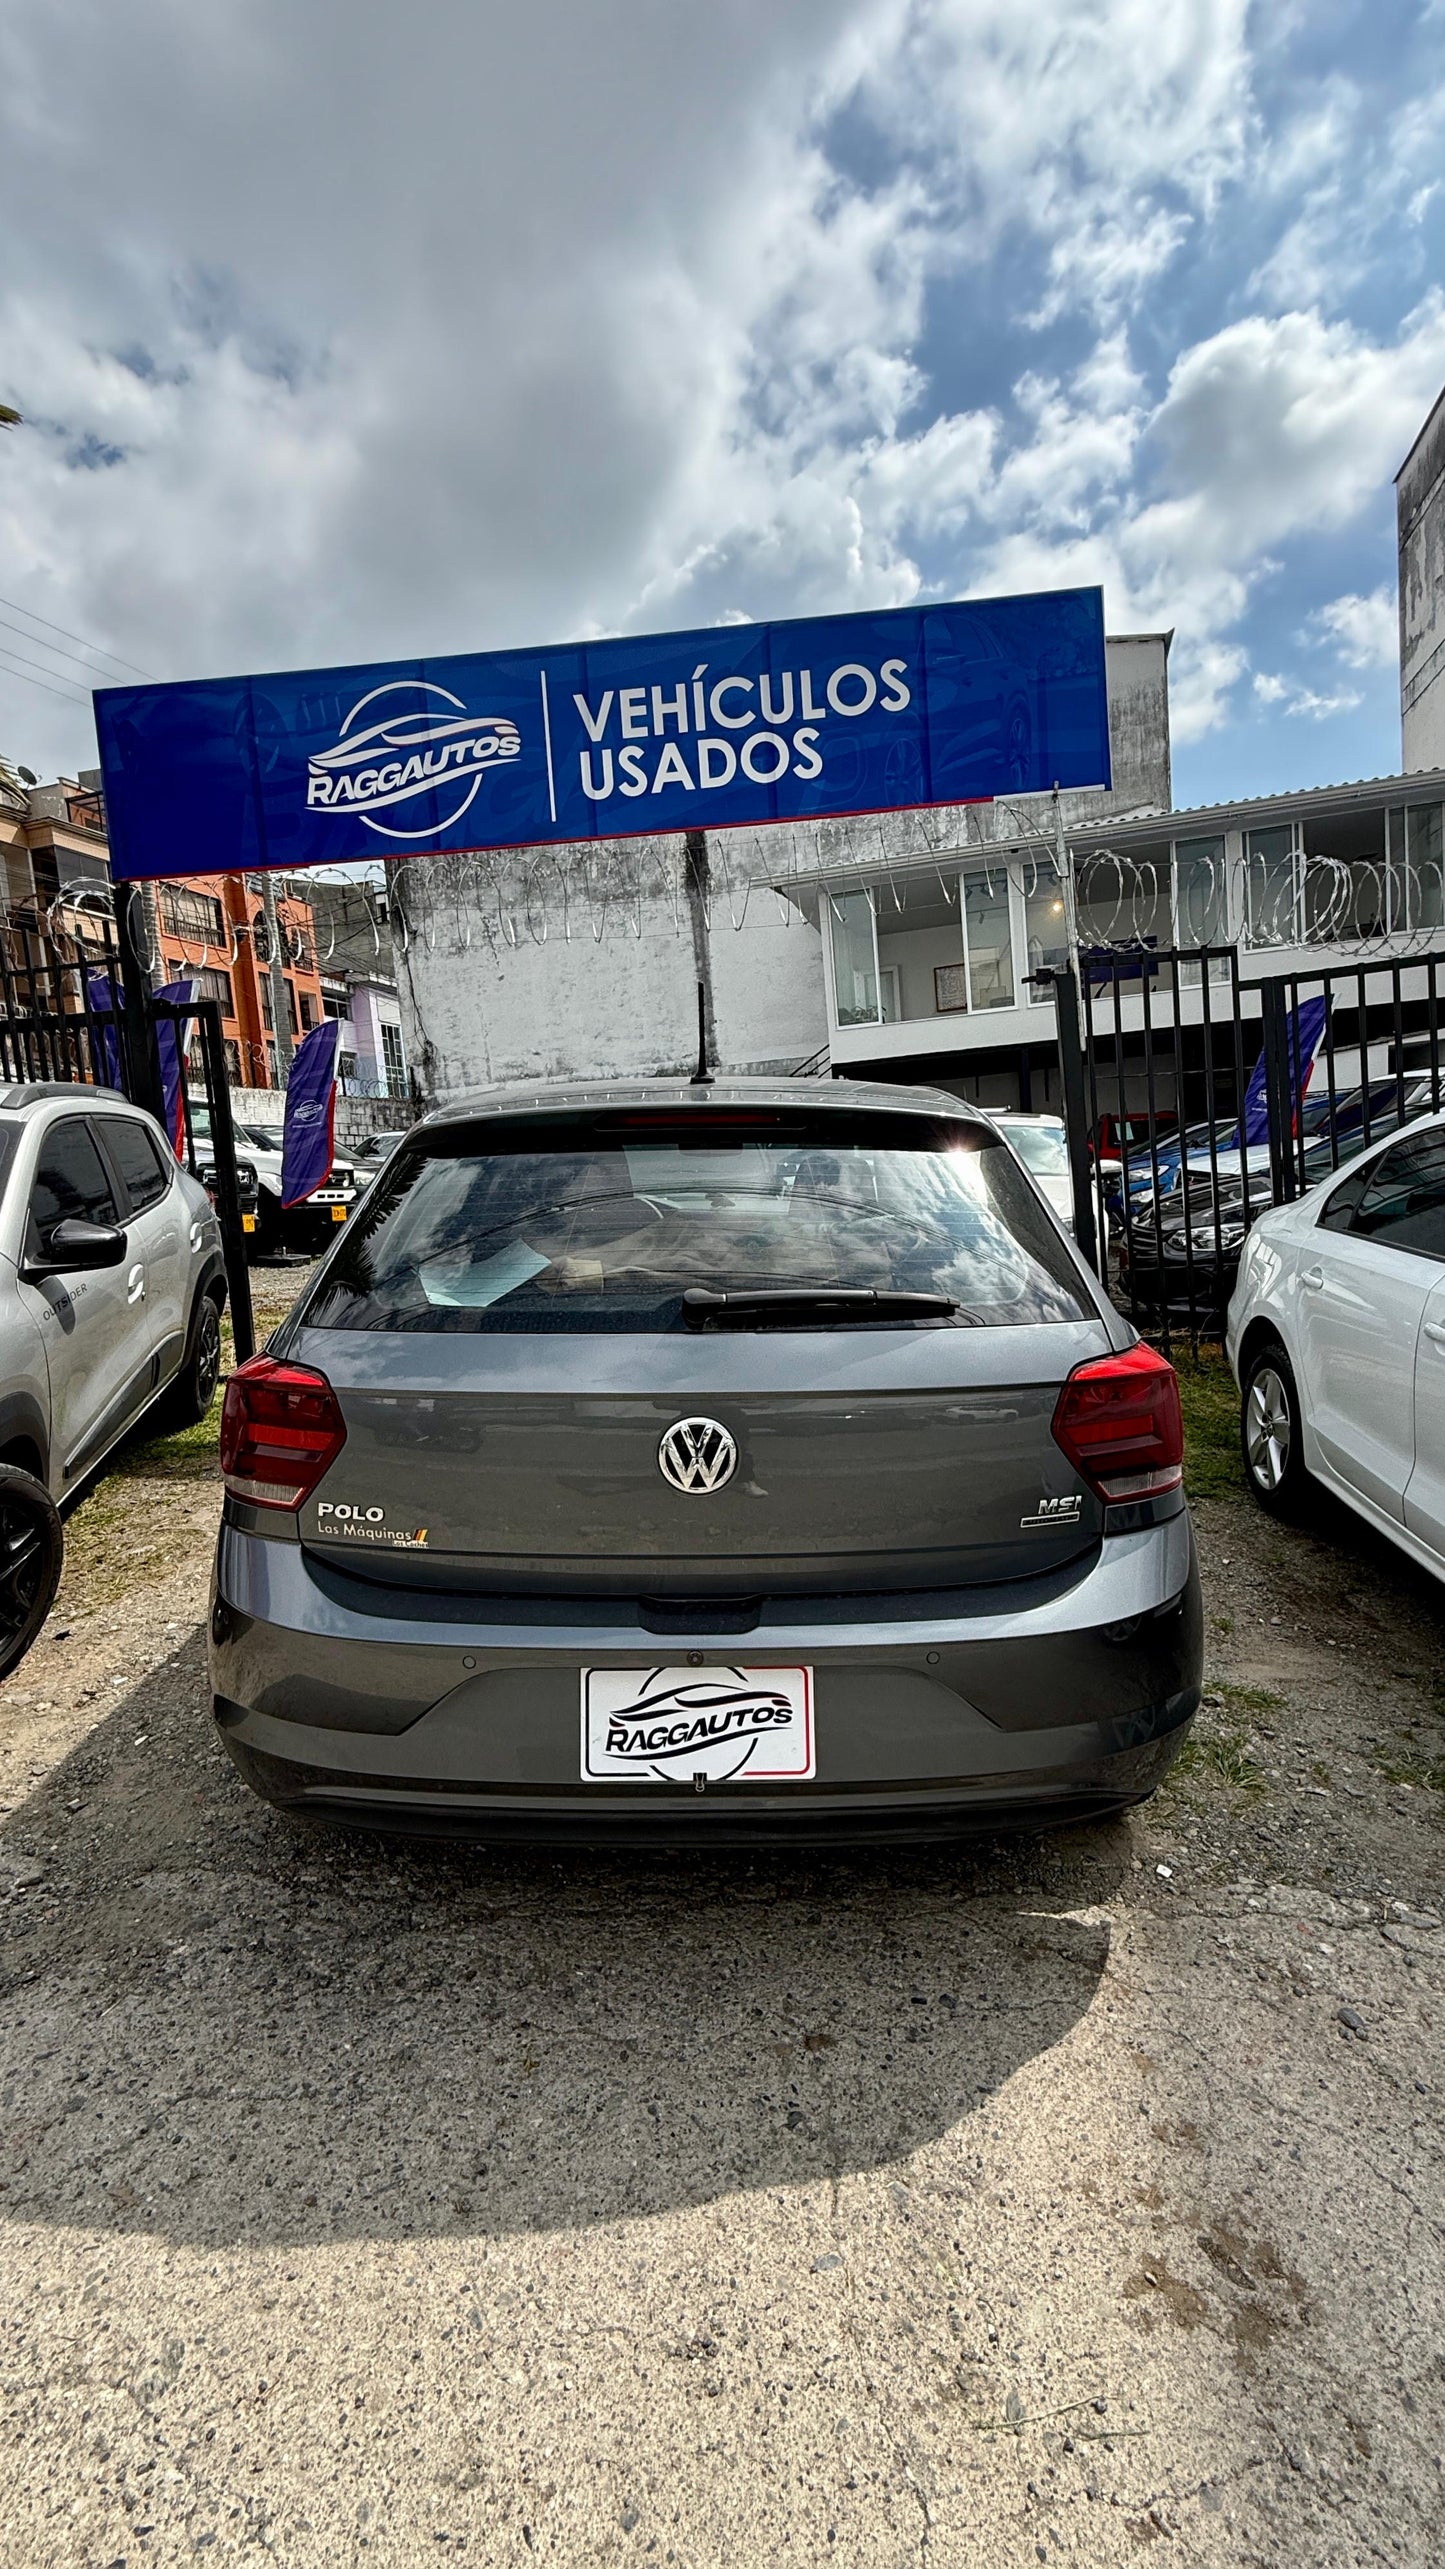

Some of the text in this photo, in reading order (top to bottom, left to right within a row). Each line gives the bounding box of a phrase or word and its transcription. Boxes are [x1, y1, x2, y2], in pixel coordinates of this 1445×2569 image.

[572, 658, 911, 743] VEHÍCULOS
[306, 735, 522, 806] RAGGAUTOS
[579, 727, 823, 801] USADOS
[42, 1283, 88, 1321] OUTSIDER
[317, 1502, 385, 1522] POLO
[1037, 1495, 1082, 1515] MSI
[317, 1520, 412, 1541] Las Máquinas
[605, 1706, 794, 1752] RAGGAUTOS
